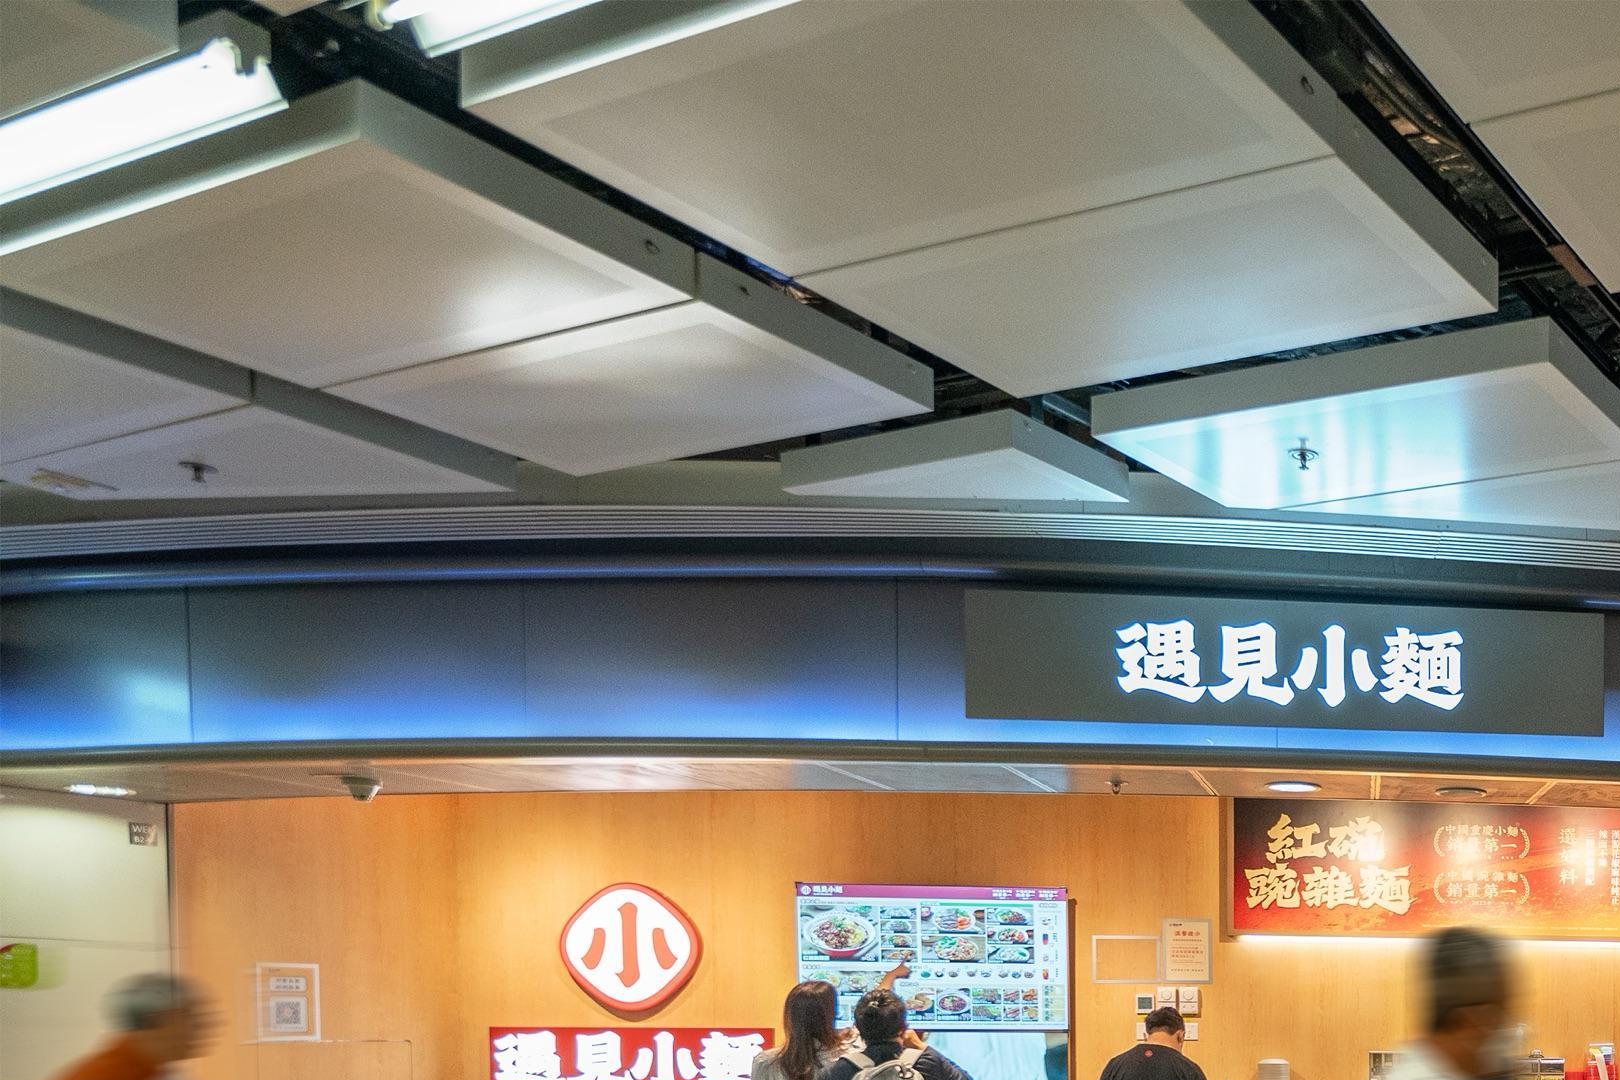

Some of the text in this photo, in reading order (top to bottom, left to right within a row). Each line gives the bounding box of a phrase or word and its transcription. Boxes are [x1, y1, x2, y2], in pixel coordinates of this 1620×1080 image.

[1115, 620, 1465, 711] 遇見小麵
[1244, 862, 1413, 916] 豌雜麵
[581, 902, 678, 988] 小
